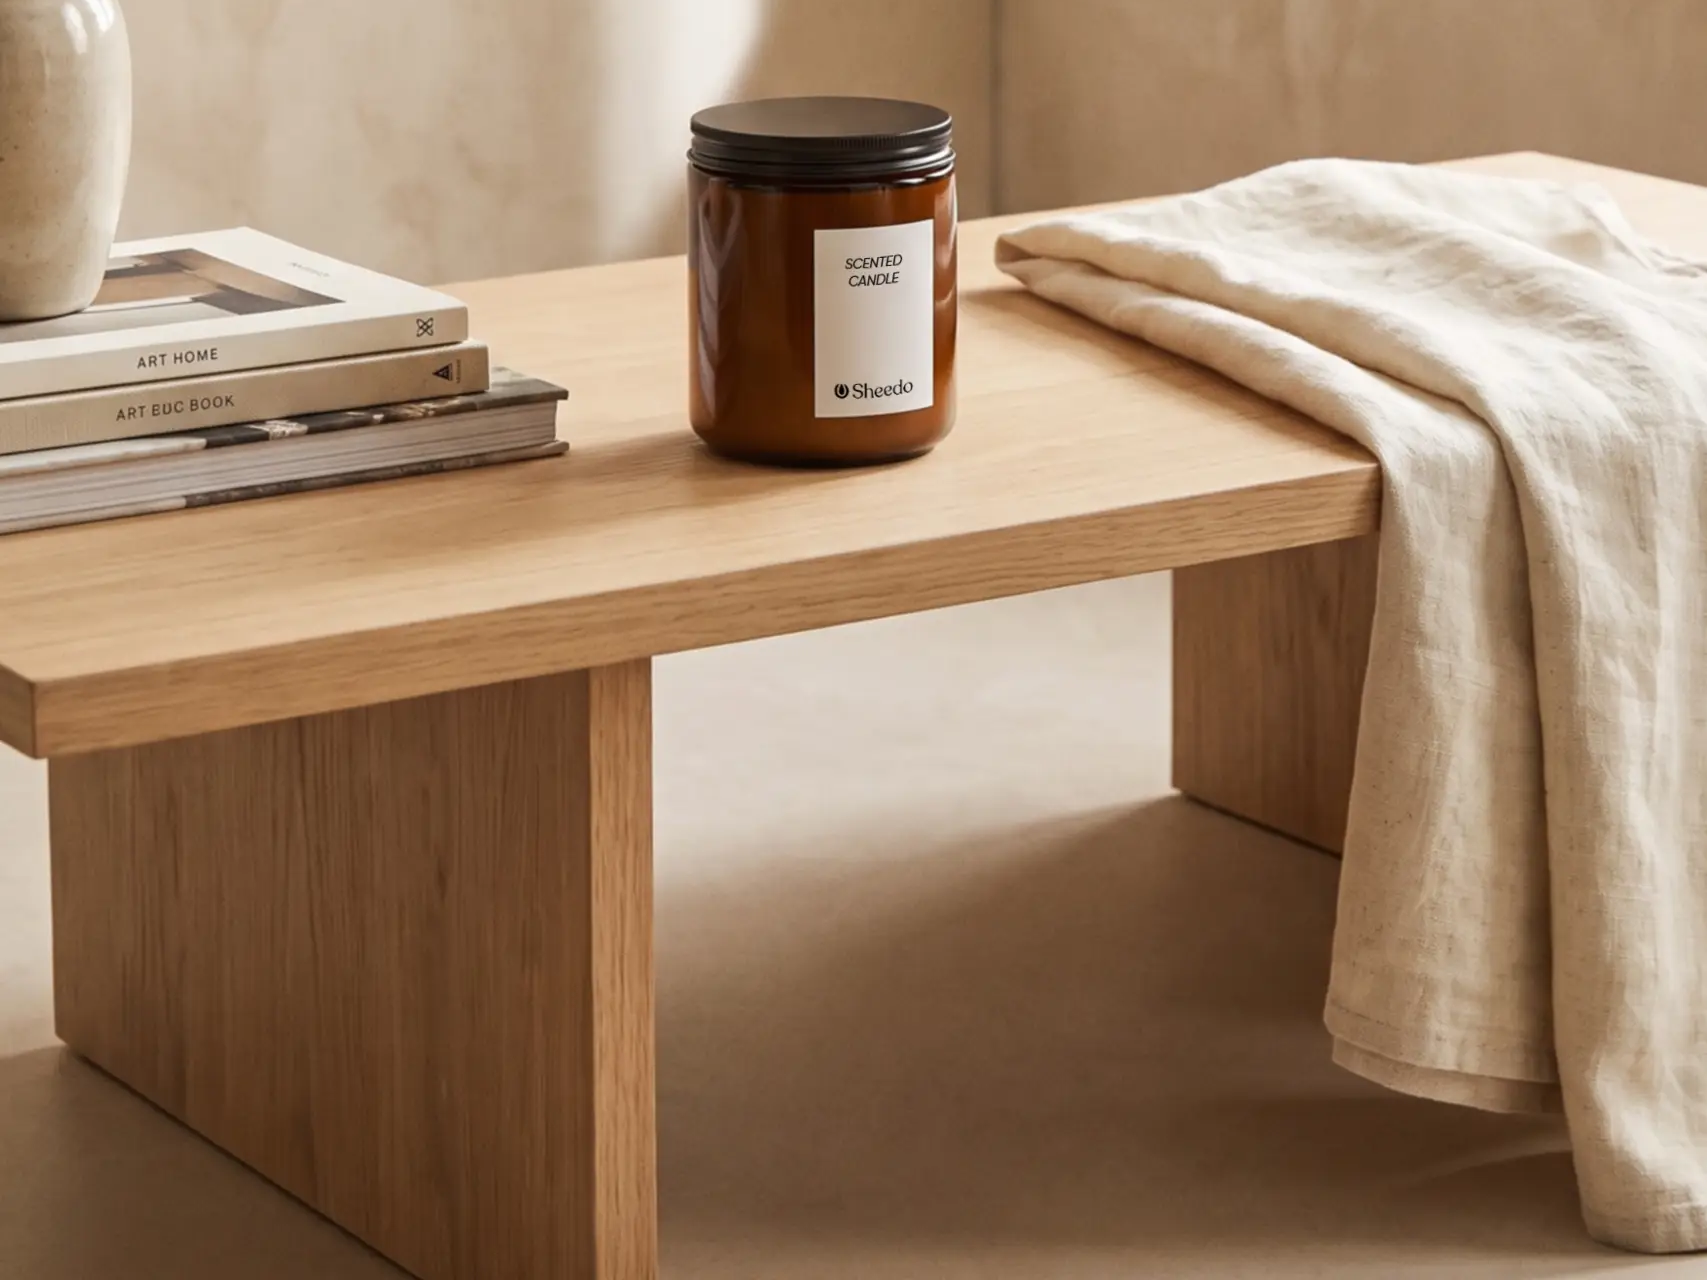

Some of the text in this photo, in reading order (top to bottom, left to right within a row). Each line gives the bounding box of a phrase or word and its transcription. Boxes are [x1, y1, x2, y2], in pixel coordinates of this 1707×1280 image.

[844, 253, 903, 270] SCENTED
[848, 271, 900, 287] CANDLE
[136, 348, 219, 369] ART HOME
[852, 379, 914, 400] Sheedo
[115, 405, 147, 422] ART
[190, 395, 236, 412] BOOK
